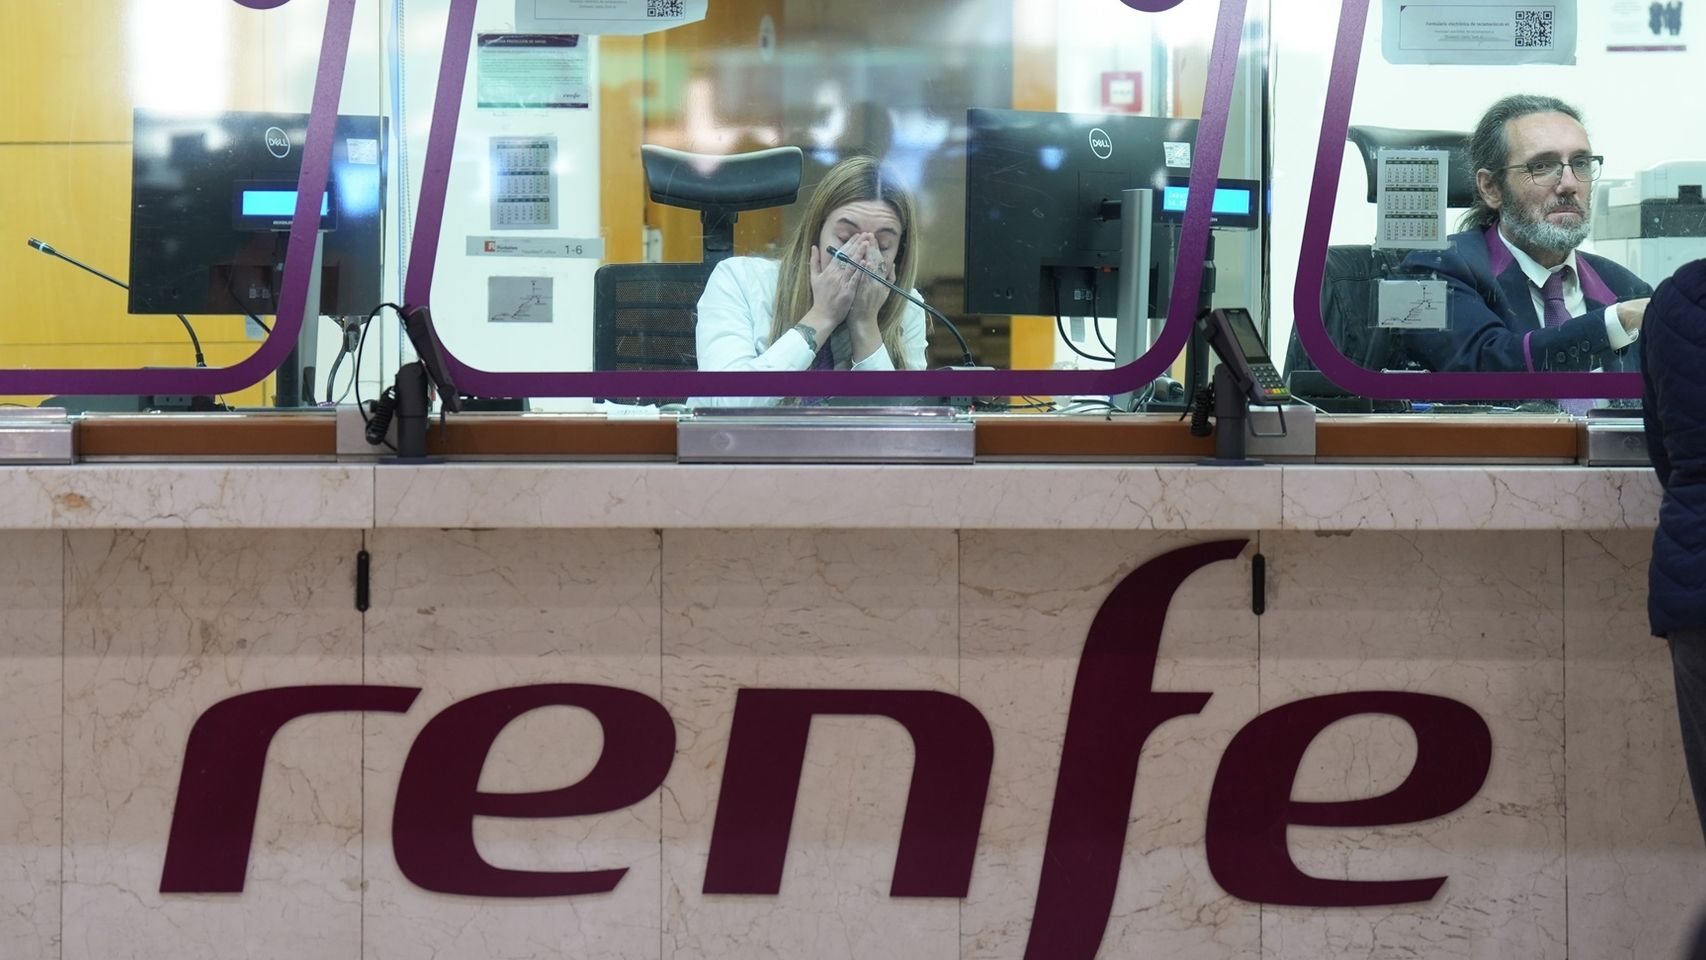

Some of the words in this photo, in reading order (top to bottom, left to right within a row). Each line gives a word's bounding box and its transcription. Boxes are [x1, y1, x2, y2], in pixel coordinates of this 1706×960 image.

[268, 137, 288, 147] DELL
[1092, 139, 1110, 148] DELL
[565, 245, 583, 255] 1-6
[160, 538, 1492, 960] renfe
